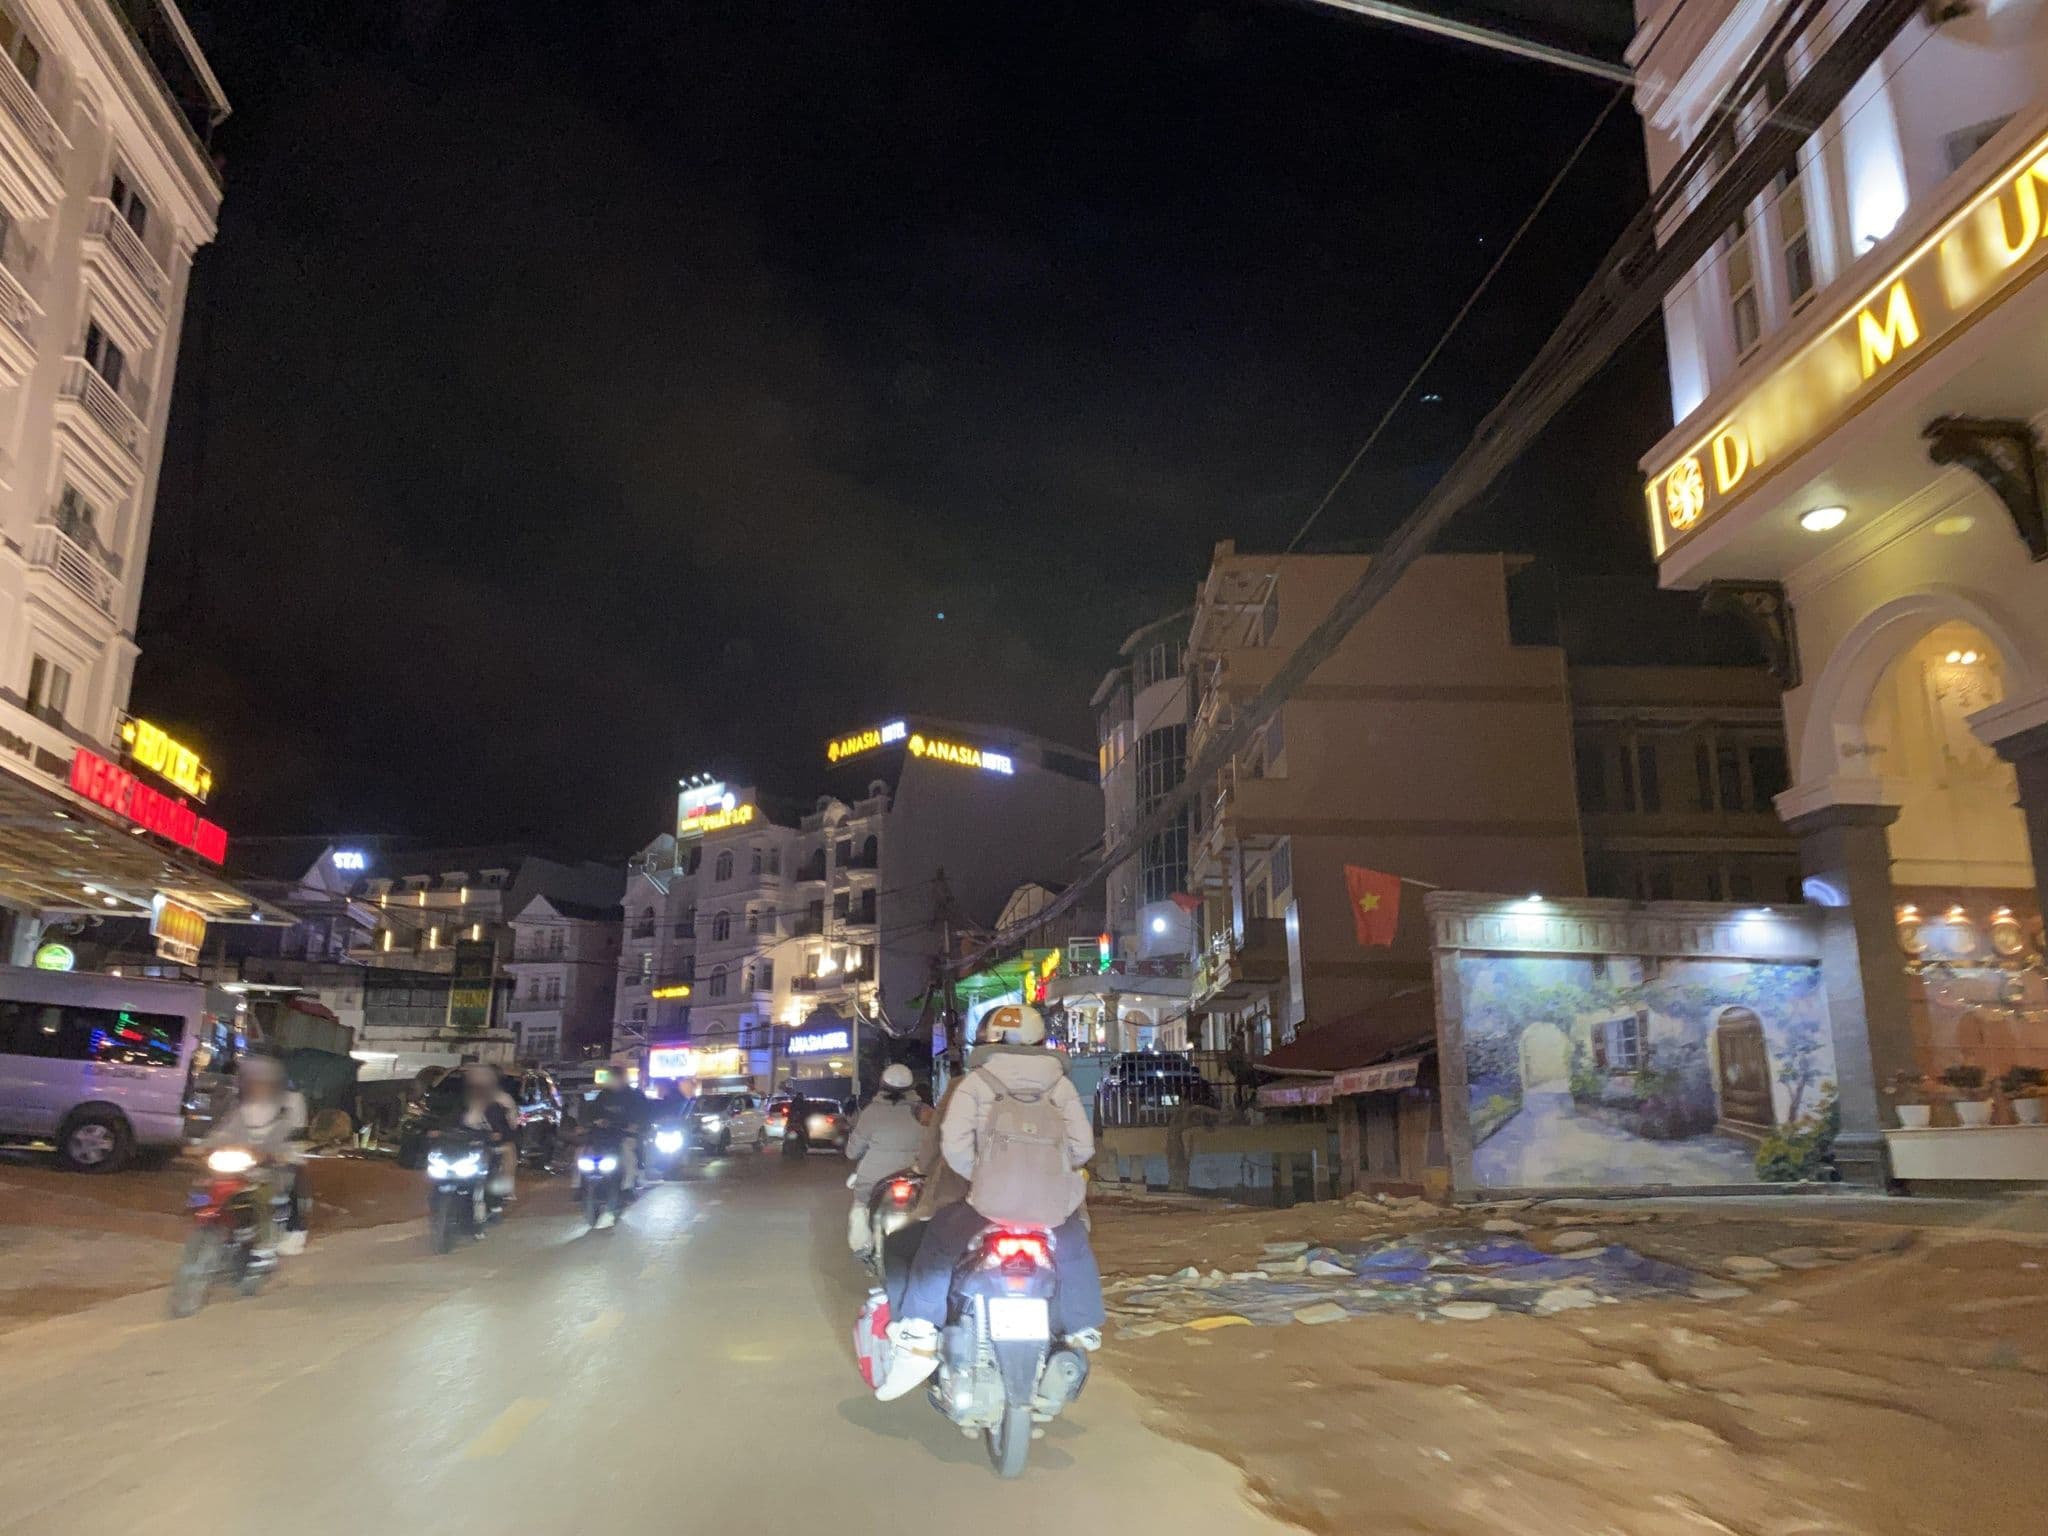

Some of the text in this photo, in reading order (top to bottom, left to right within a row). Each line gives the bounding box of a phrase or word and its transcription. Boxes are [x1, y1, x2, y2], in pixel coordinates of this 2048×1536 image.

[132, 718, 200, 795] HOTEL
[839, 730, 881, 757] ANASIA
[926, 741, 982, 768] ANASIA
